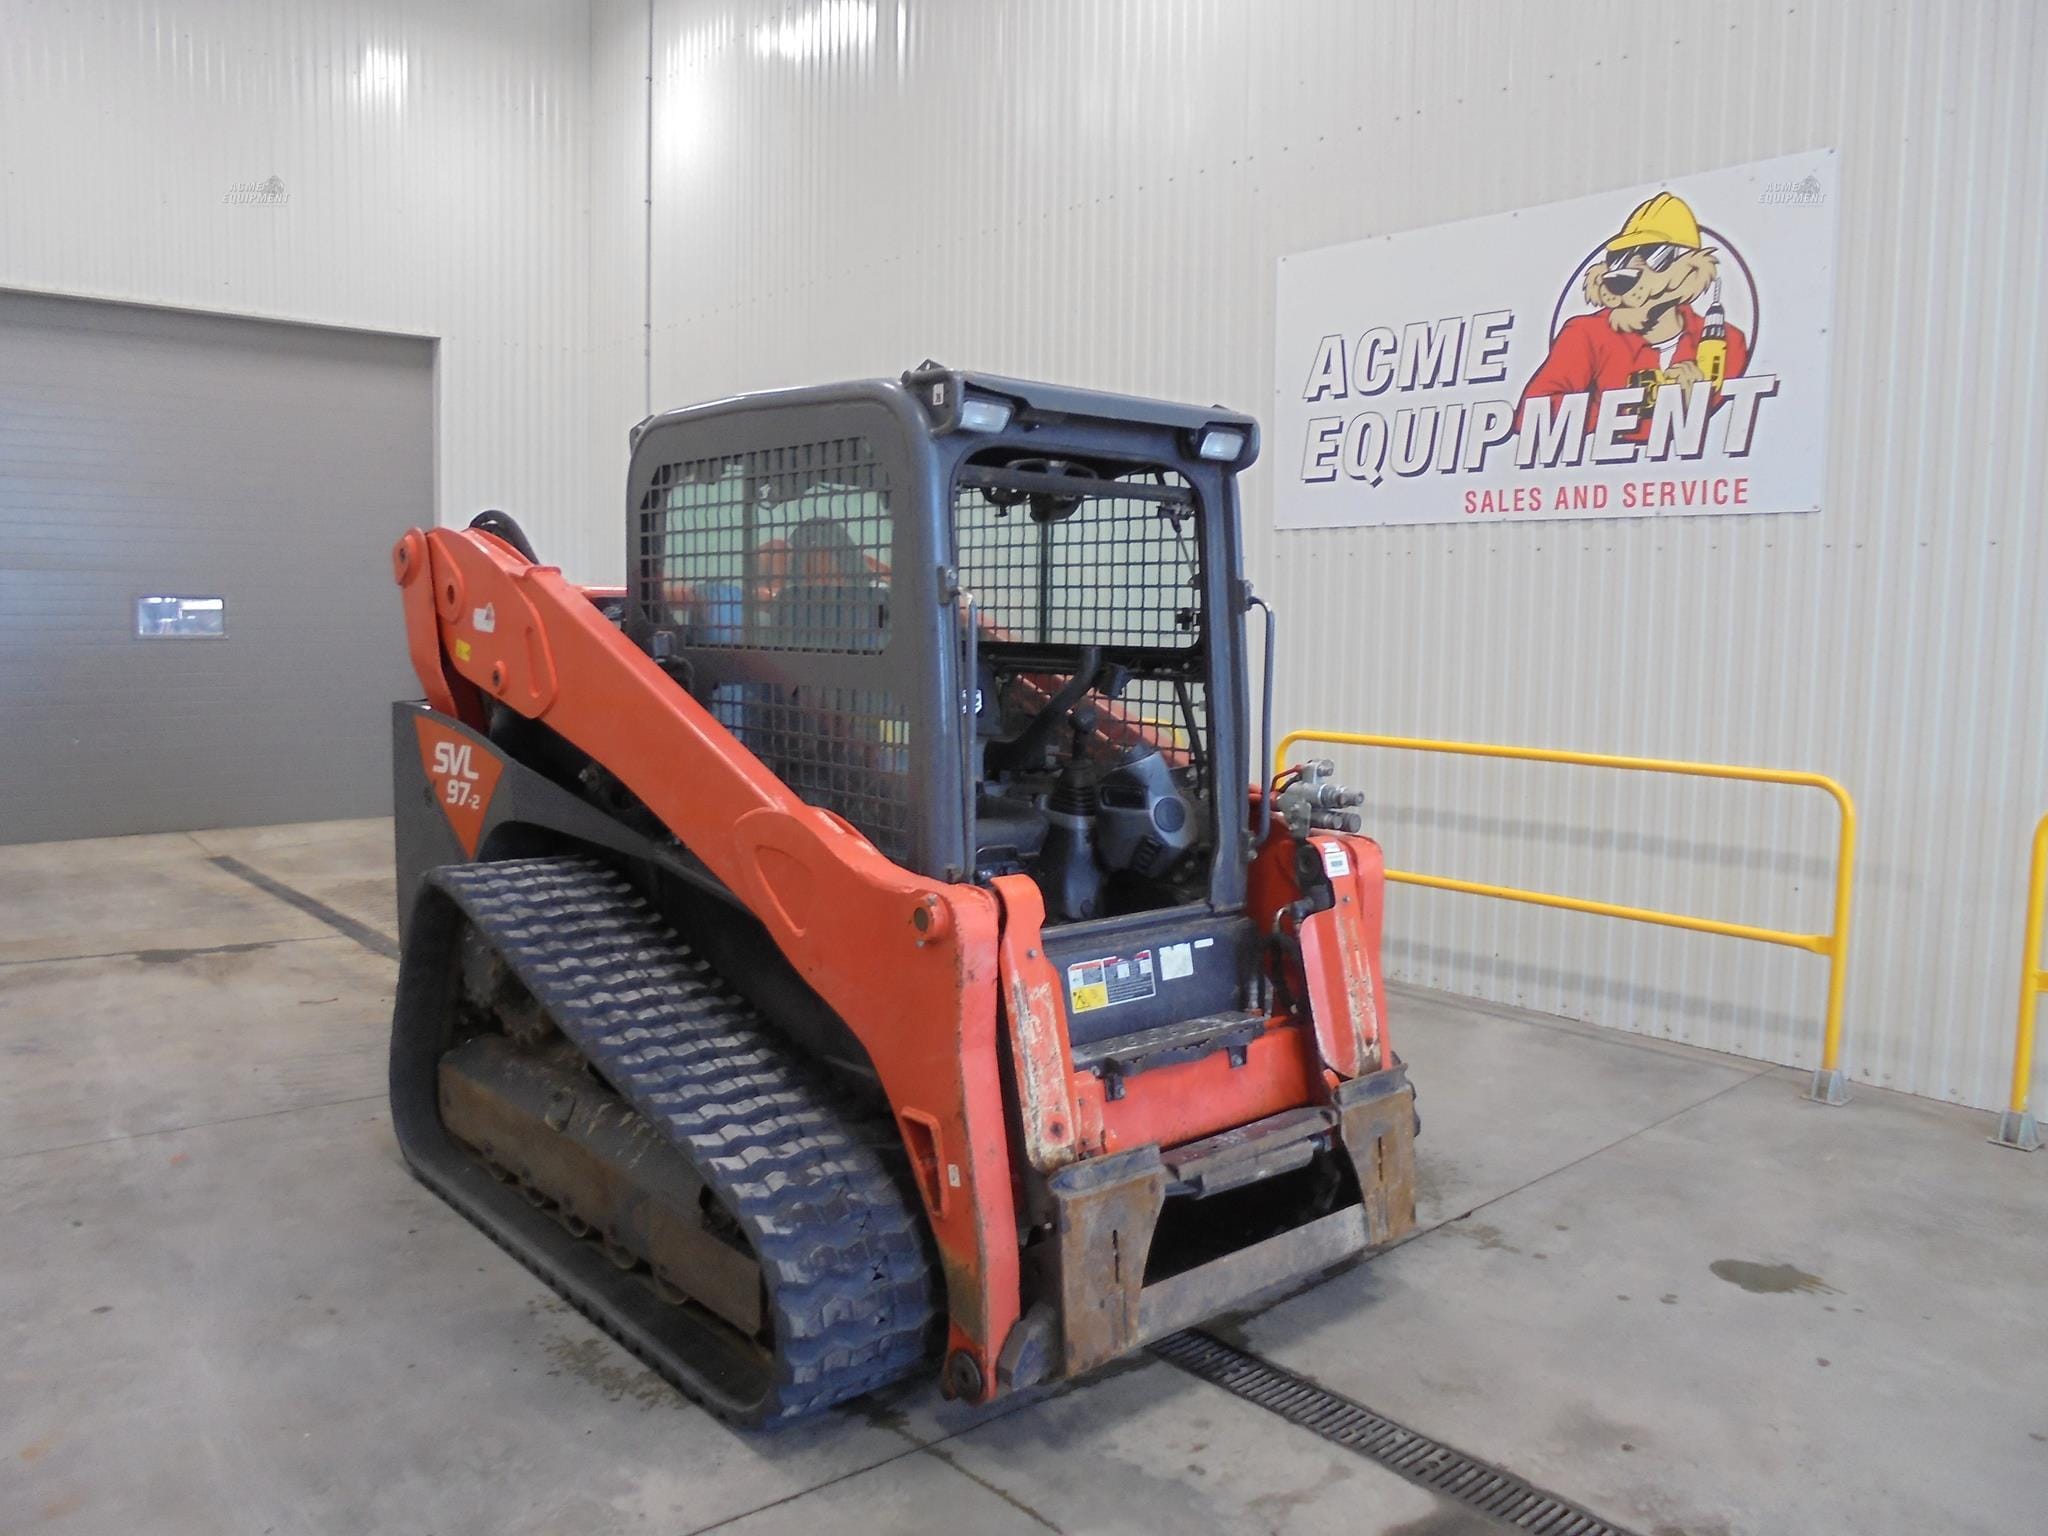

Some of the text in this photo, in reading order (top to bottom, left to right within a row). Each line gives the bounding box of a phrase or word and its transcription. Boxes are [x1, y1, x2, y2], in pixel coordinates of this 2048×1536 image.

[1302, 309, 1515, 403] ACME
[1301, 374, 1780, 488] EQUIPMENT
[1464, 478, 1750, 514] SALES AND SERVICE
[432, 742, 479, 779] SVL
[446, 779, 481, 810] 97-2
